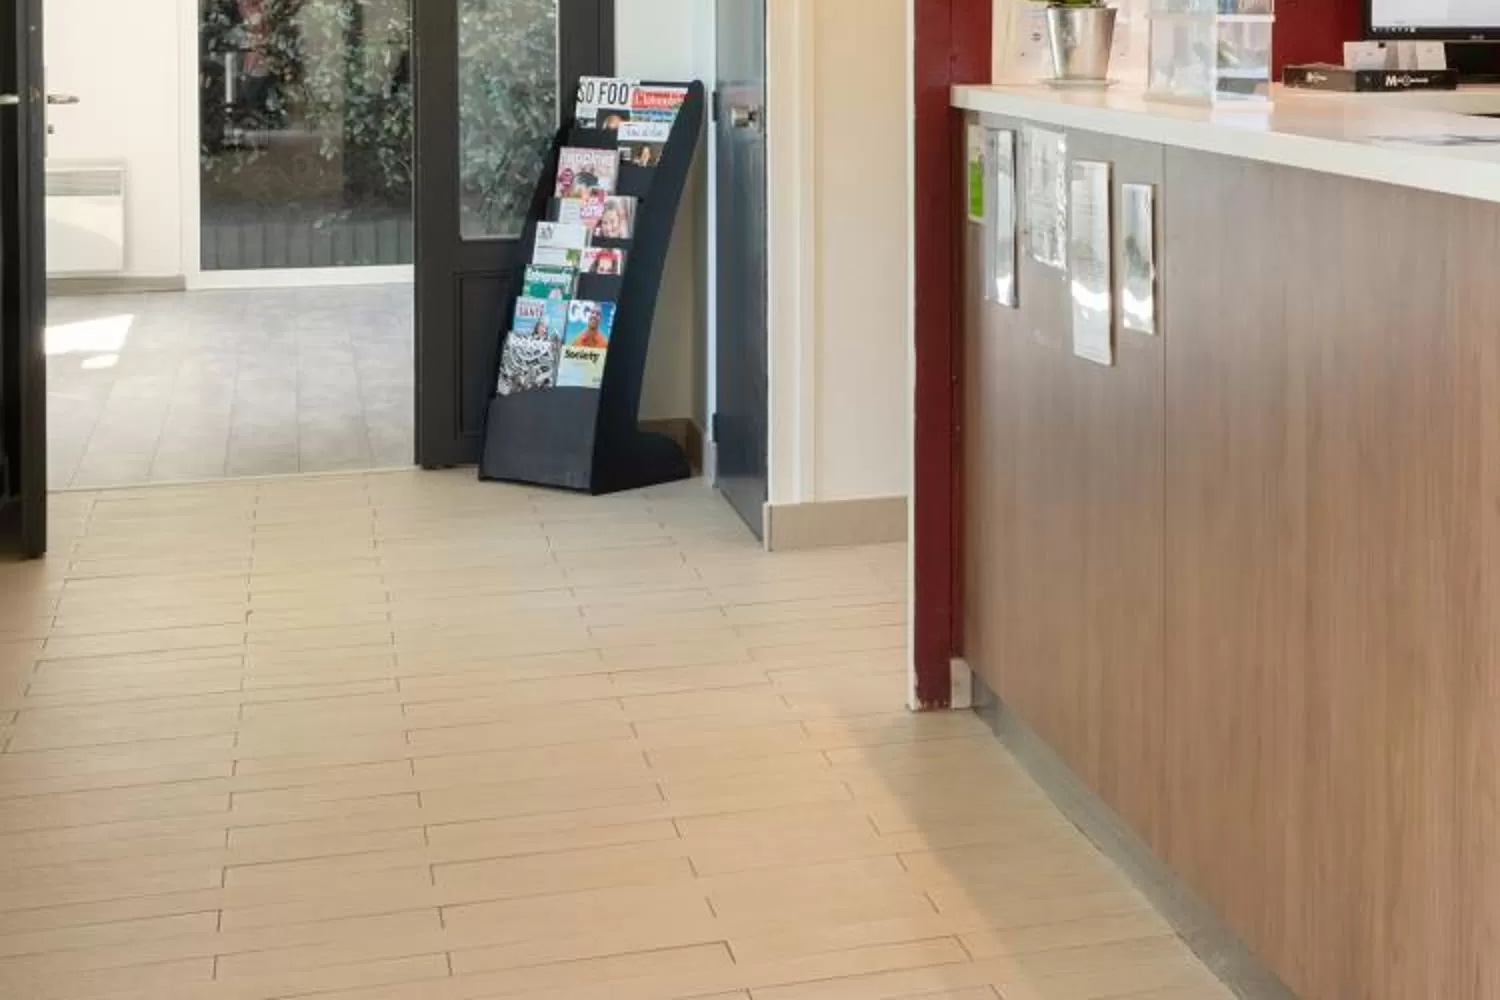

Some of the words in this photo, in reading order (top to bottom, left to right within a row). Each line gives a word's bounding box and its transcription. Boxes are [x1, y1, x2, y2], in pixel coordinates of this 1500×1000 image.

[577, 80, 595, 103] SO
[598, 81, 637, 105] FOO
[564, 348, 600, 364] Society
